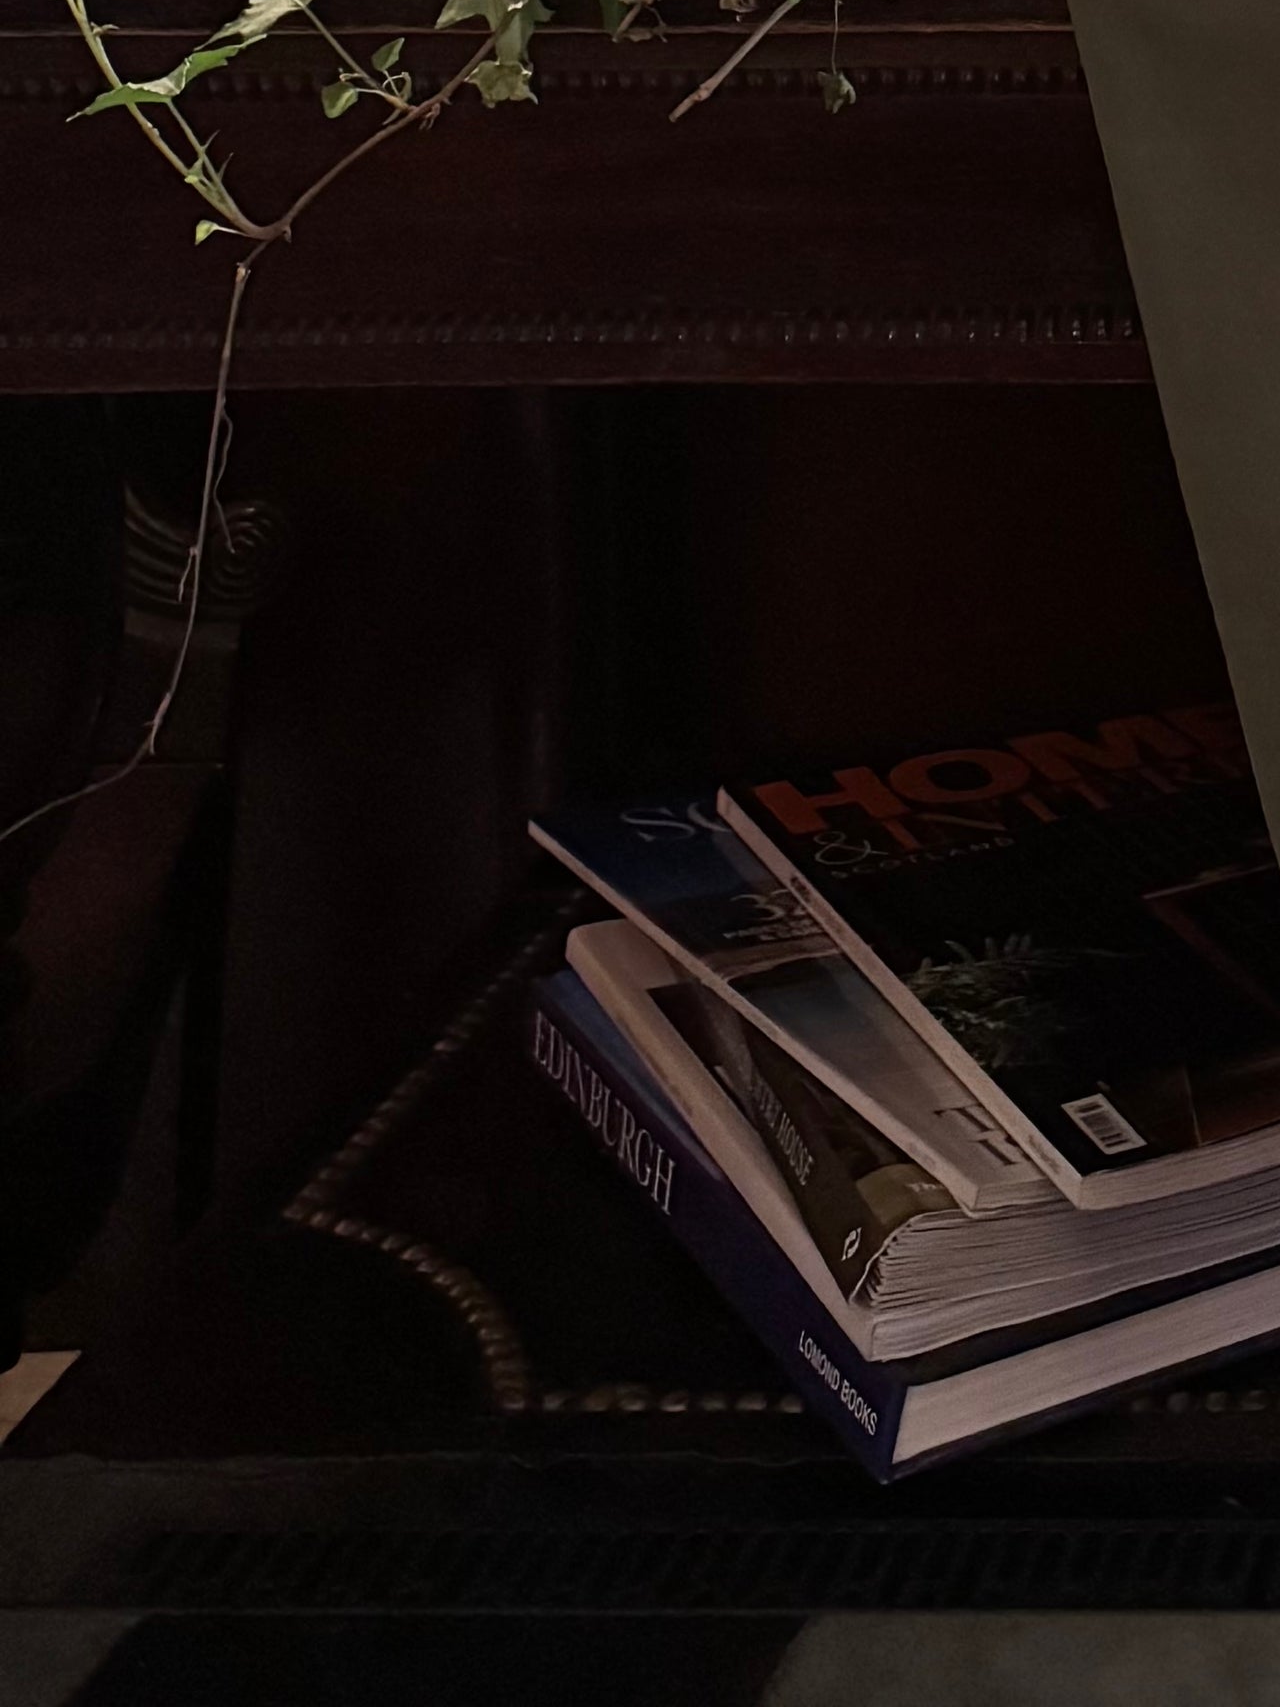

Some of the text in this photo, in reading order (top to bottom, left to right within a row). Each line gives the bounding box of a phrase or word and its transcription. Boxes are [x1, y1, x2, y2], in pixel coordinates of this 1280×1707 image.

[534, 1009, 677, 1216] EDINBURGH
[798, 1329, 878, 1436] LOMOND BOOKS
